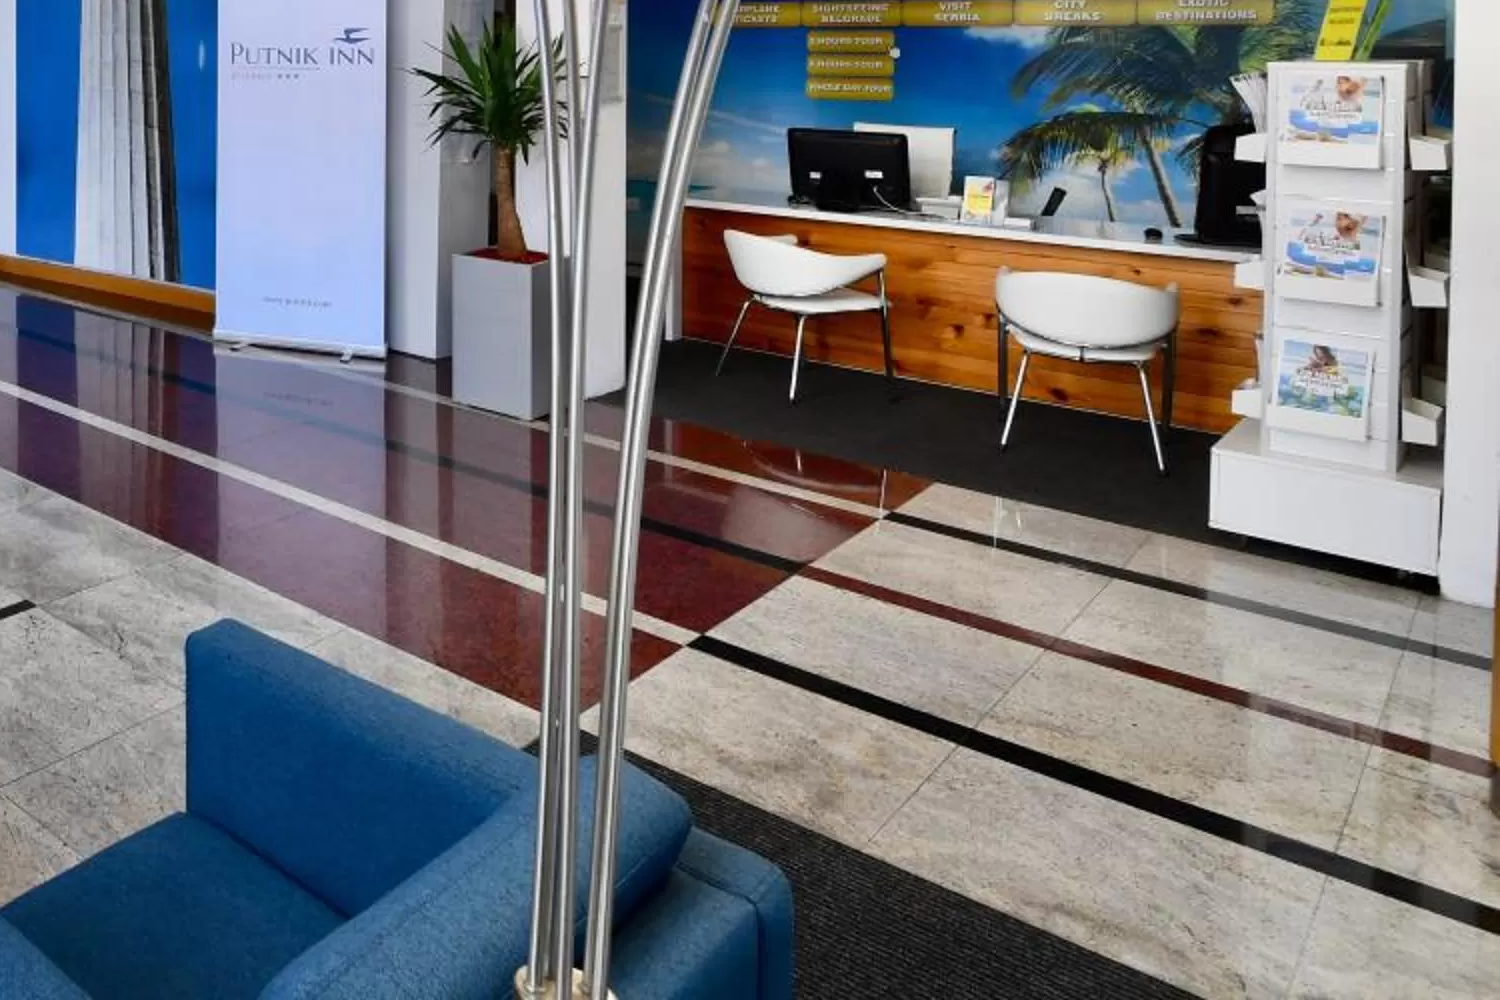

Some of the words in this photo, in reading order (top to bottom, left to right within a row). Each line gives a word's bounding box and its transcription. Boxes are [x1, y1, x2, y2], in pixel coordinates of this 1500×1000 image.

[812, 3, 891, 13] SIGHTSEEING
[939, 1, 973, 11] VISIT
[1053, 0, 1087, 9] CITY
[819, 14, 883, 23] BELGRADE
[933, 12, 981, 22] SERBIA
[1043, 10, 1102, 21] BREAKS
[1155, 9, 1258, 21] DESTINATIONS
[230, 42, 319, 65] PUTNIK
[329, 47, 376, 66] INN
